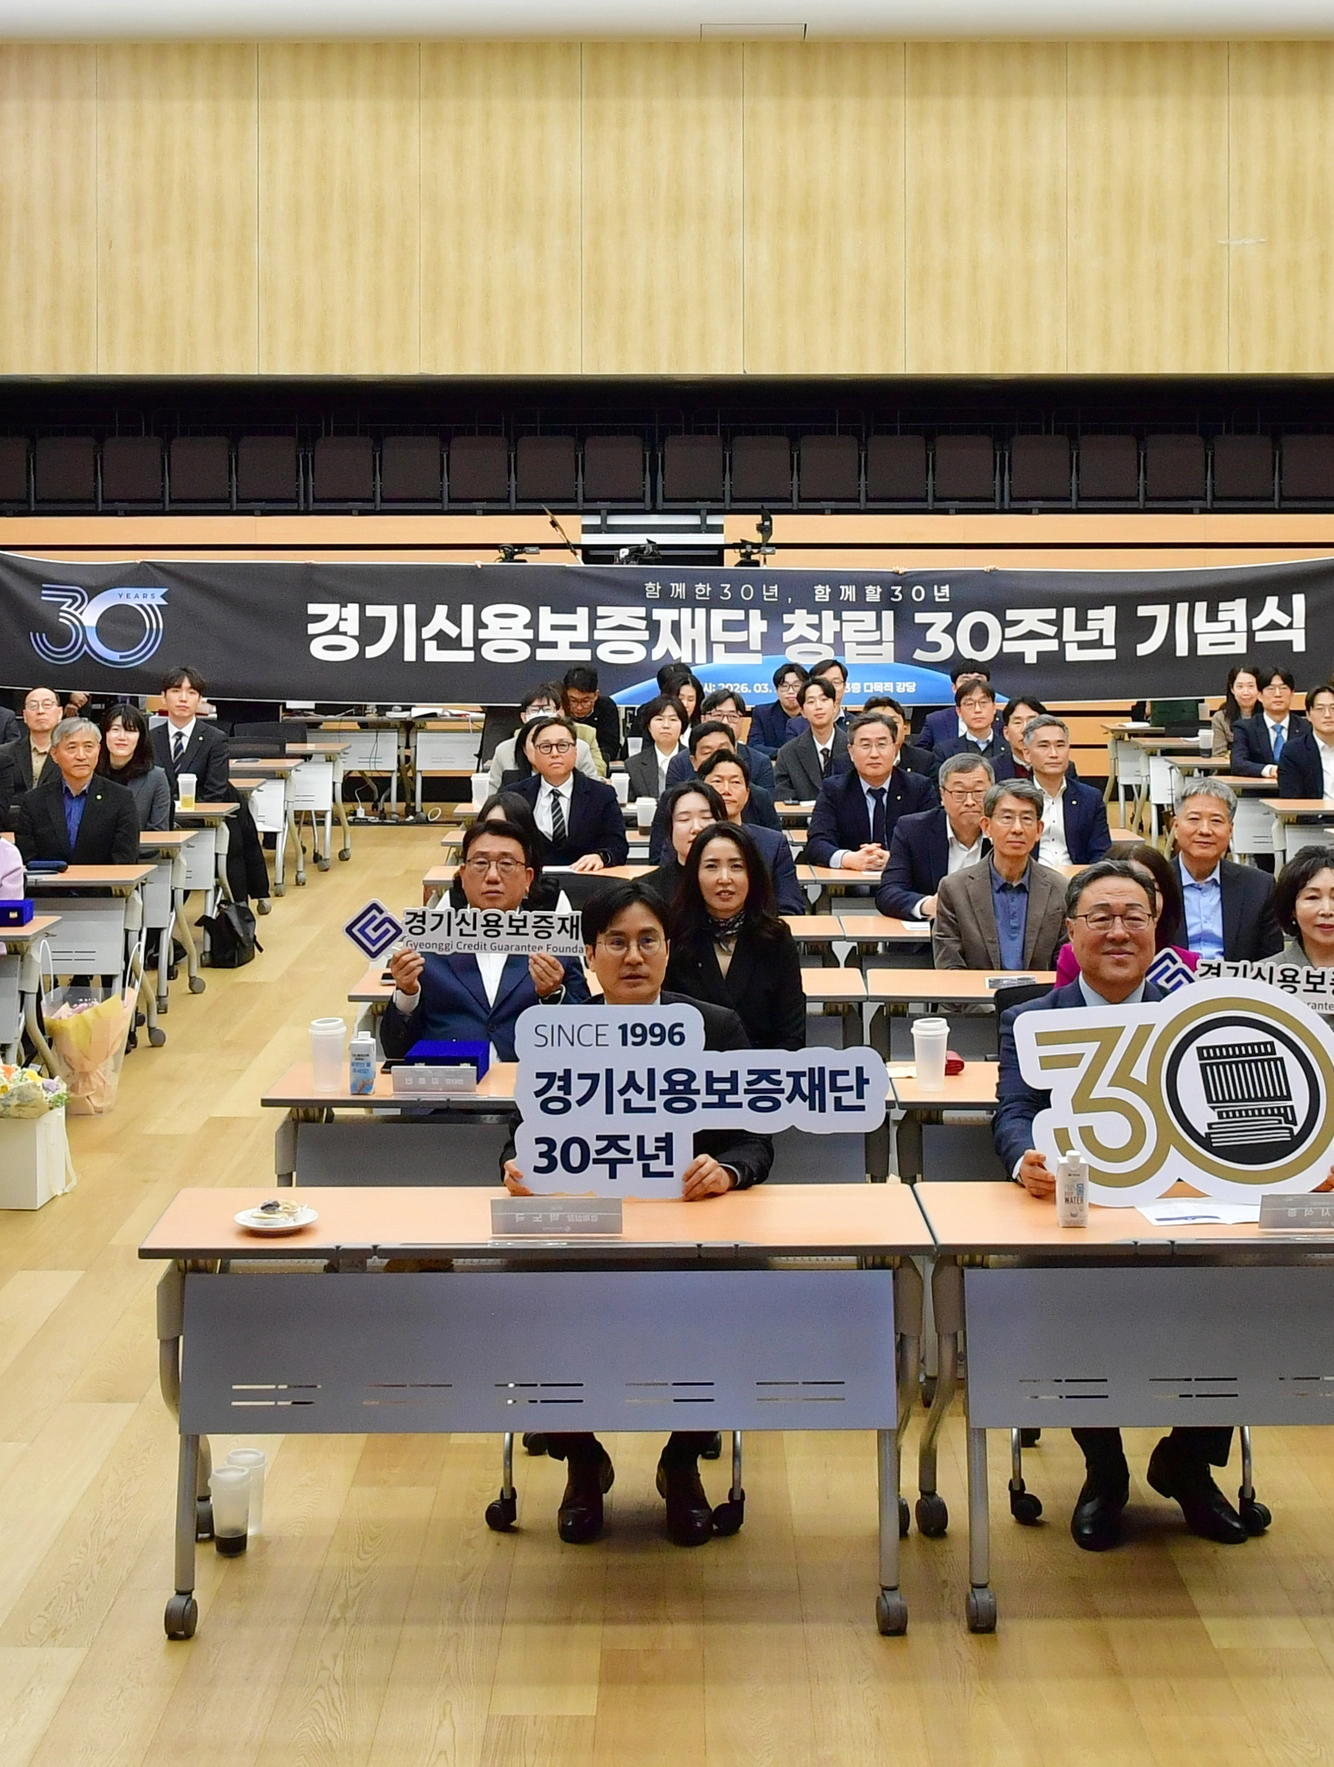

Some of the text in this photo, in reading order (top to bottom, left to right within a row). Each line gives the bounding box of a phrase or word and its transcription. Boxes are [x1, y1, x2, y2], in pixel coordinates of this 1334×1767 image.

[118, 592, 156, 600] YEARS
[307, 593, 1307, 667] 경기신용보증재단 창립 30주년 기념식
[863, 682, 893, 693] 다목적
[896, 682, 917, 693] 강당
[404, 911, 581, 940] 경기신용보증재
[455, 941, 487, 951] Credit
[490, 942, 544, 953] Guarantee
[546, 943, 584, 954] Founda
[533, 1022, 686, 1048] SINCE 1996
[533, 1066, 870, 1116] 경기신용보증재단
[532, 1131, 675, 1180] 30주년
